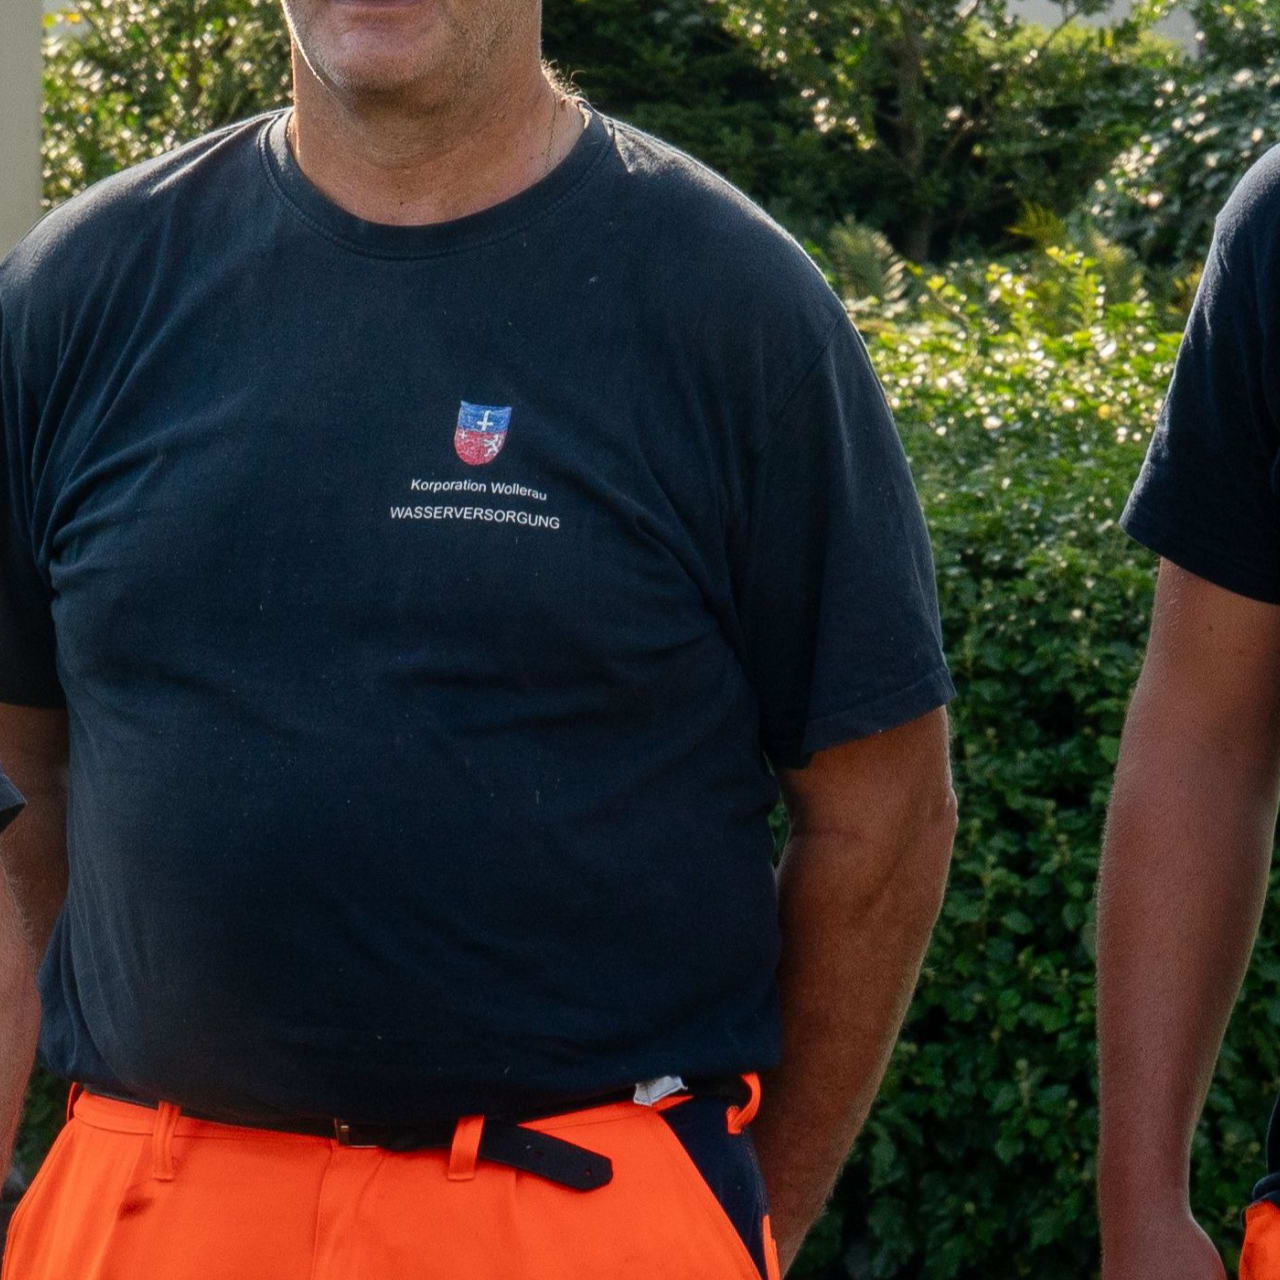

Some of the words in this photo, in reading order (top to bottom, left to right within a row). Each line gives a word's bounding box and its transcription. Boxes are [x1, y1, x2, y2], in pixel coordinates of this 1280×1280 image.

[412, 479, 487, 493] Korporation
[491, 482, 547, 501] Wollerau
[390, 506, 560, 529] WASSERVERSORGUNG
